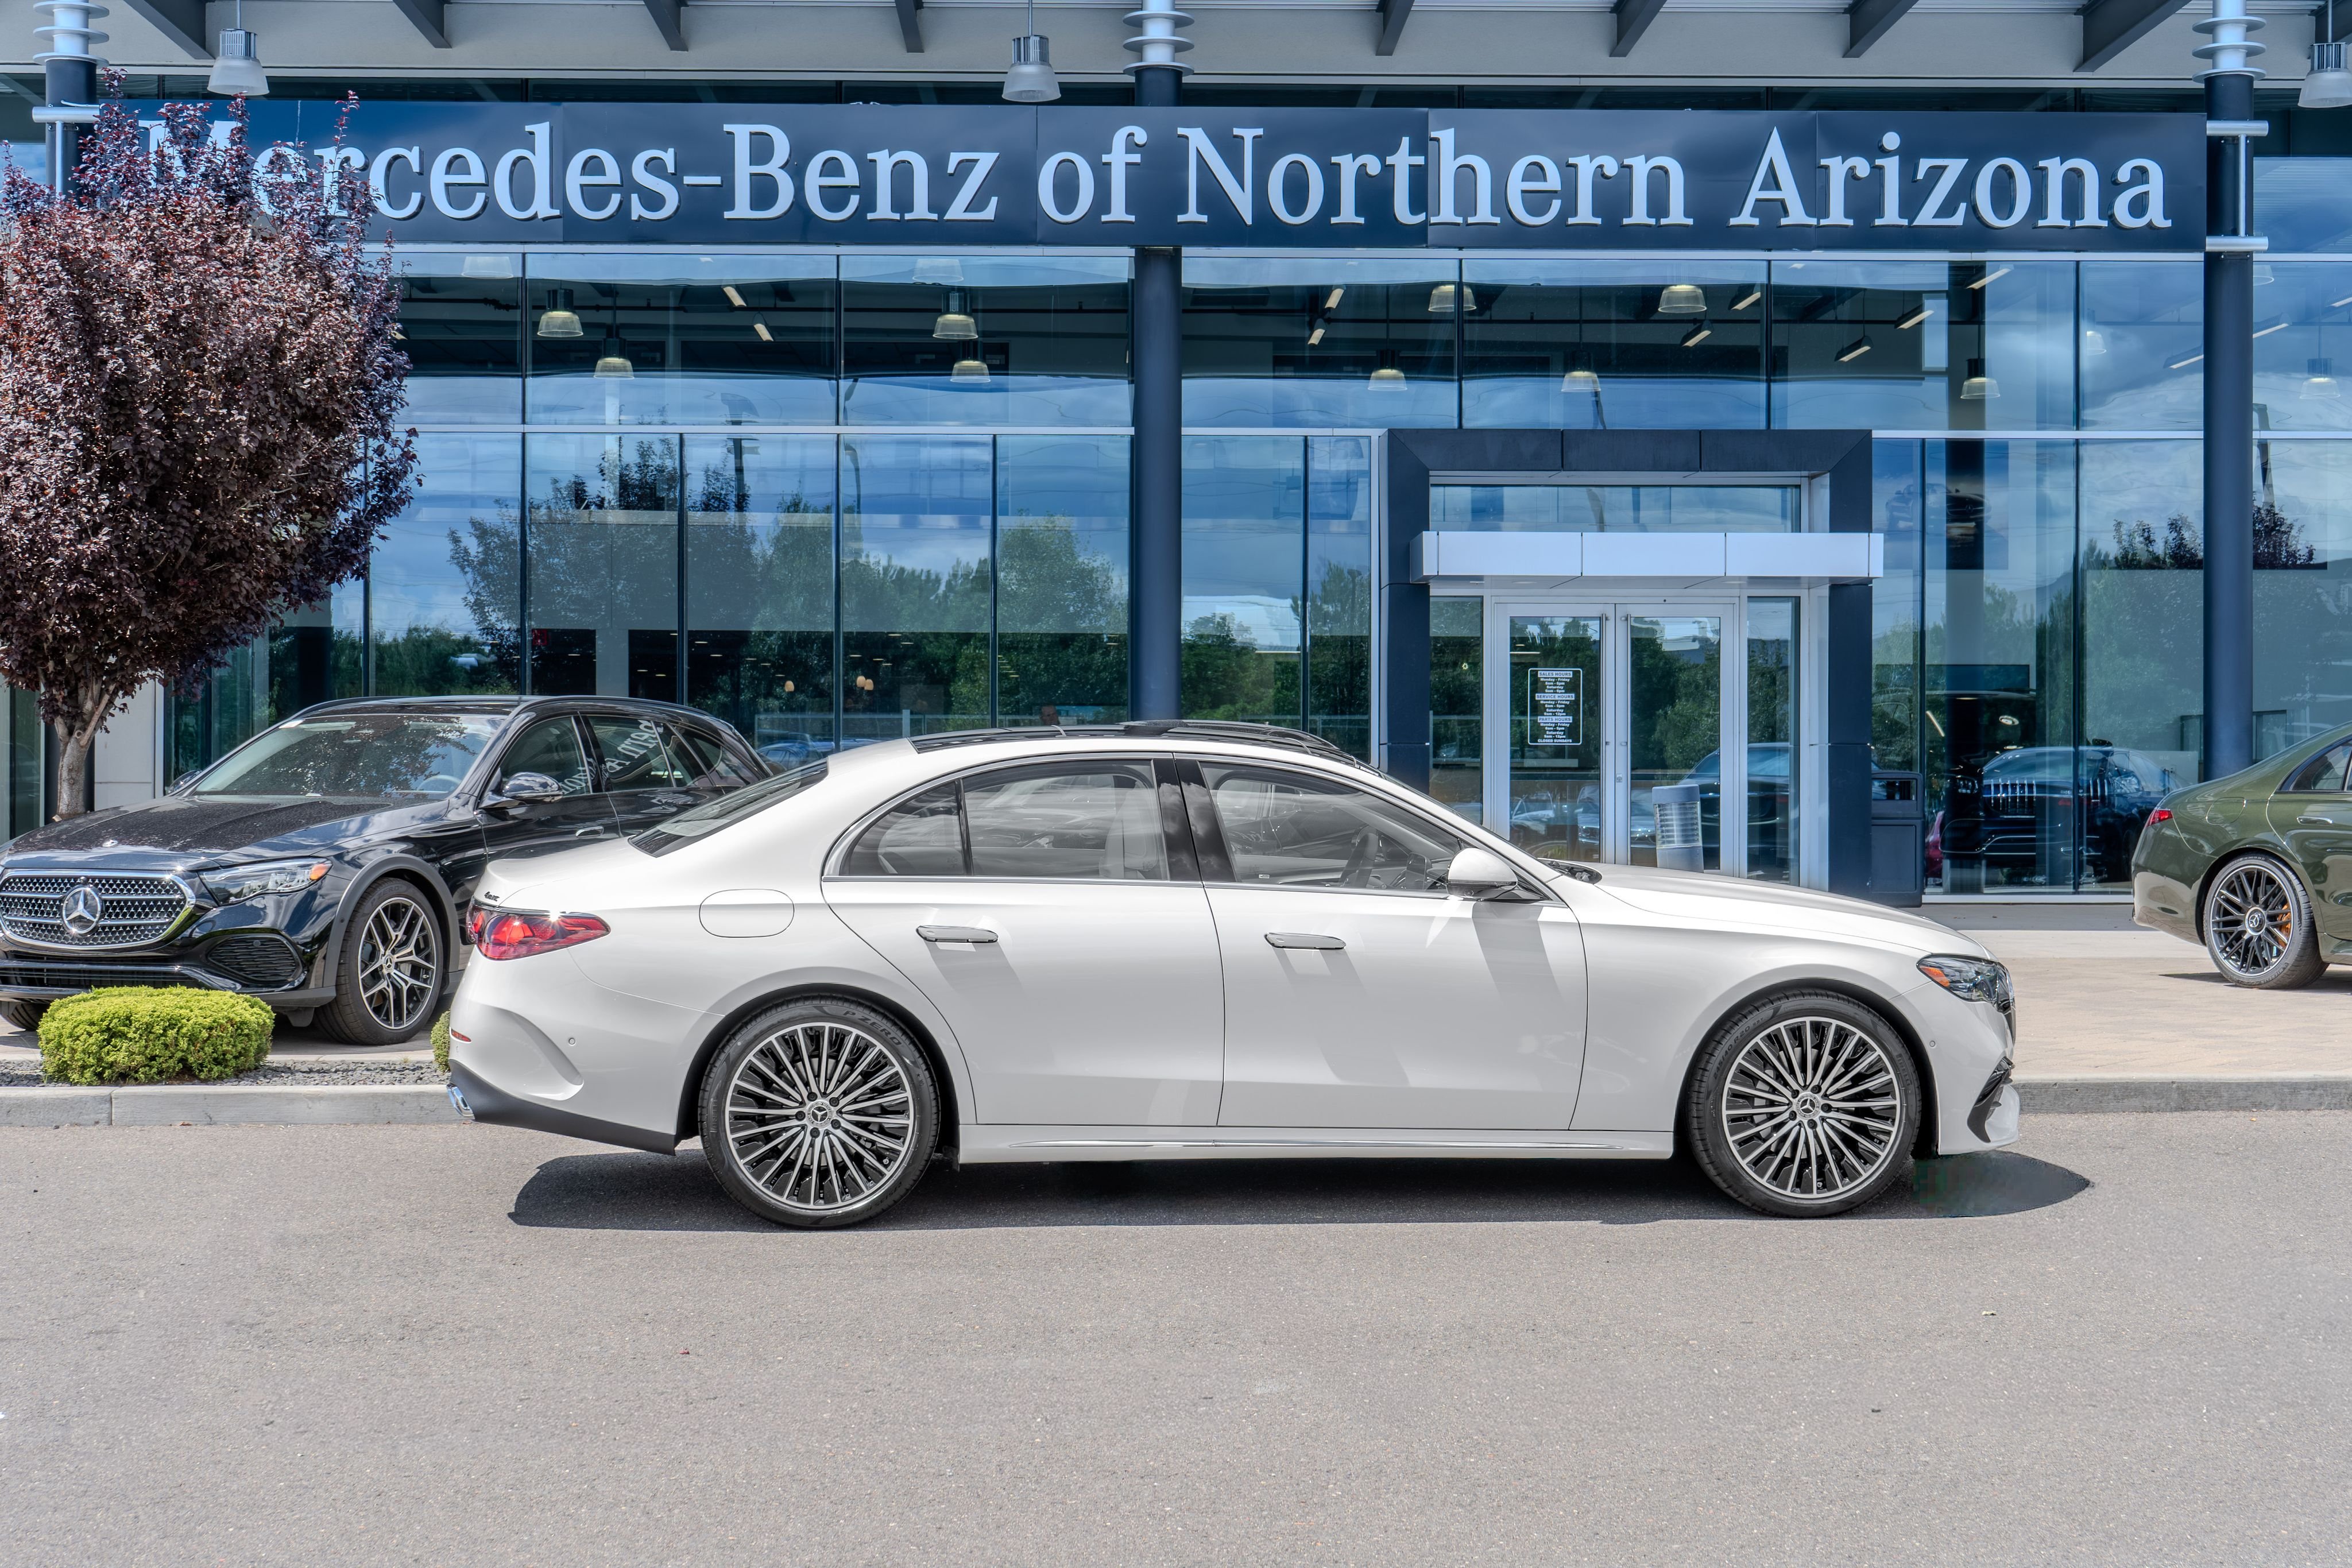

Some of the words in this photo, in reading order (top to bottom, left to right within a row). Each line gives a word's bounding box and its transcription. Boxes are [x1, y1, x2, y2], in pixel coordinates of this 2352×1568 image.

[1037, 125, 1148, 224] of
[1177, 127, 1693, 227] Northern
[1726, 126, 2172, 229] Arizona
[858, 1016, 902, 1046] ZERO
